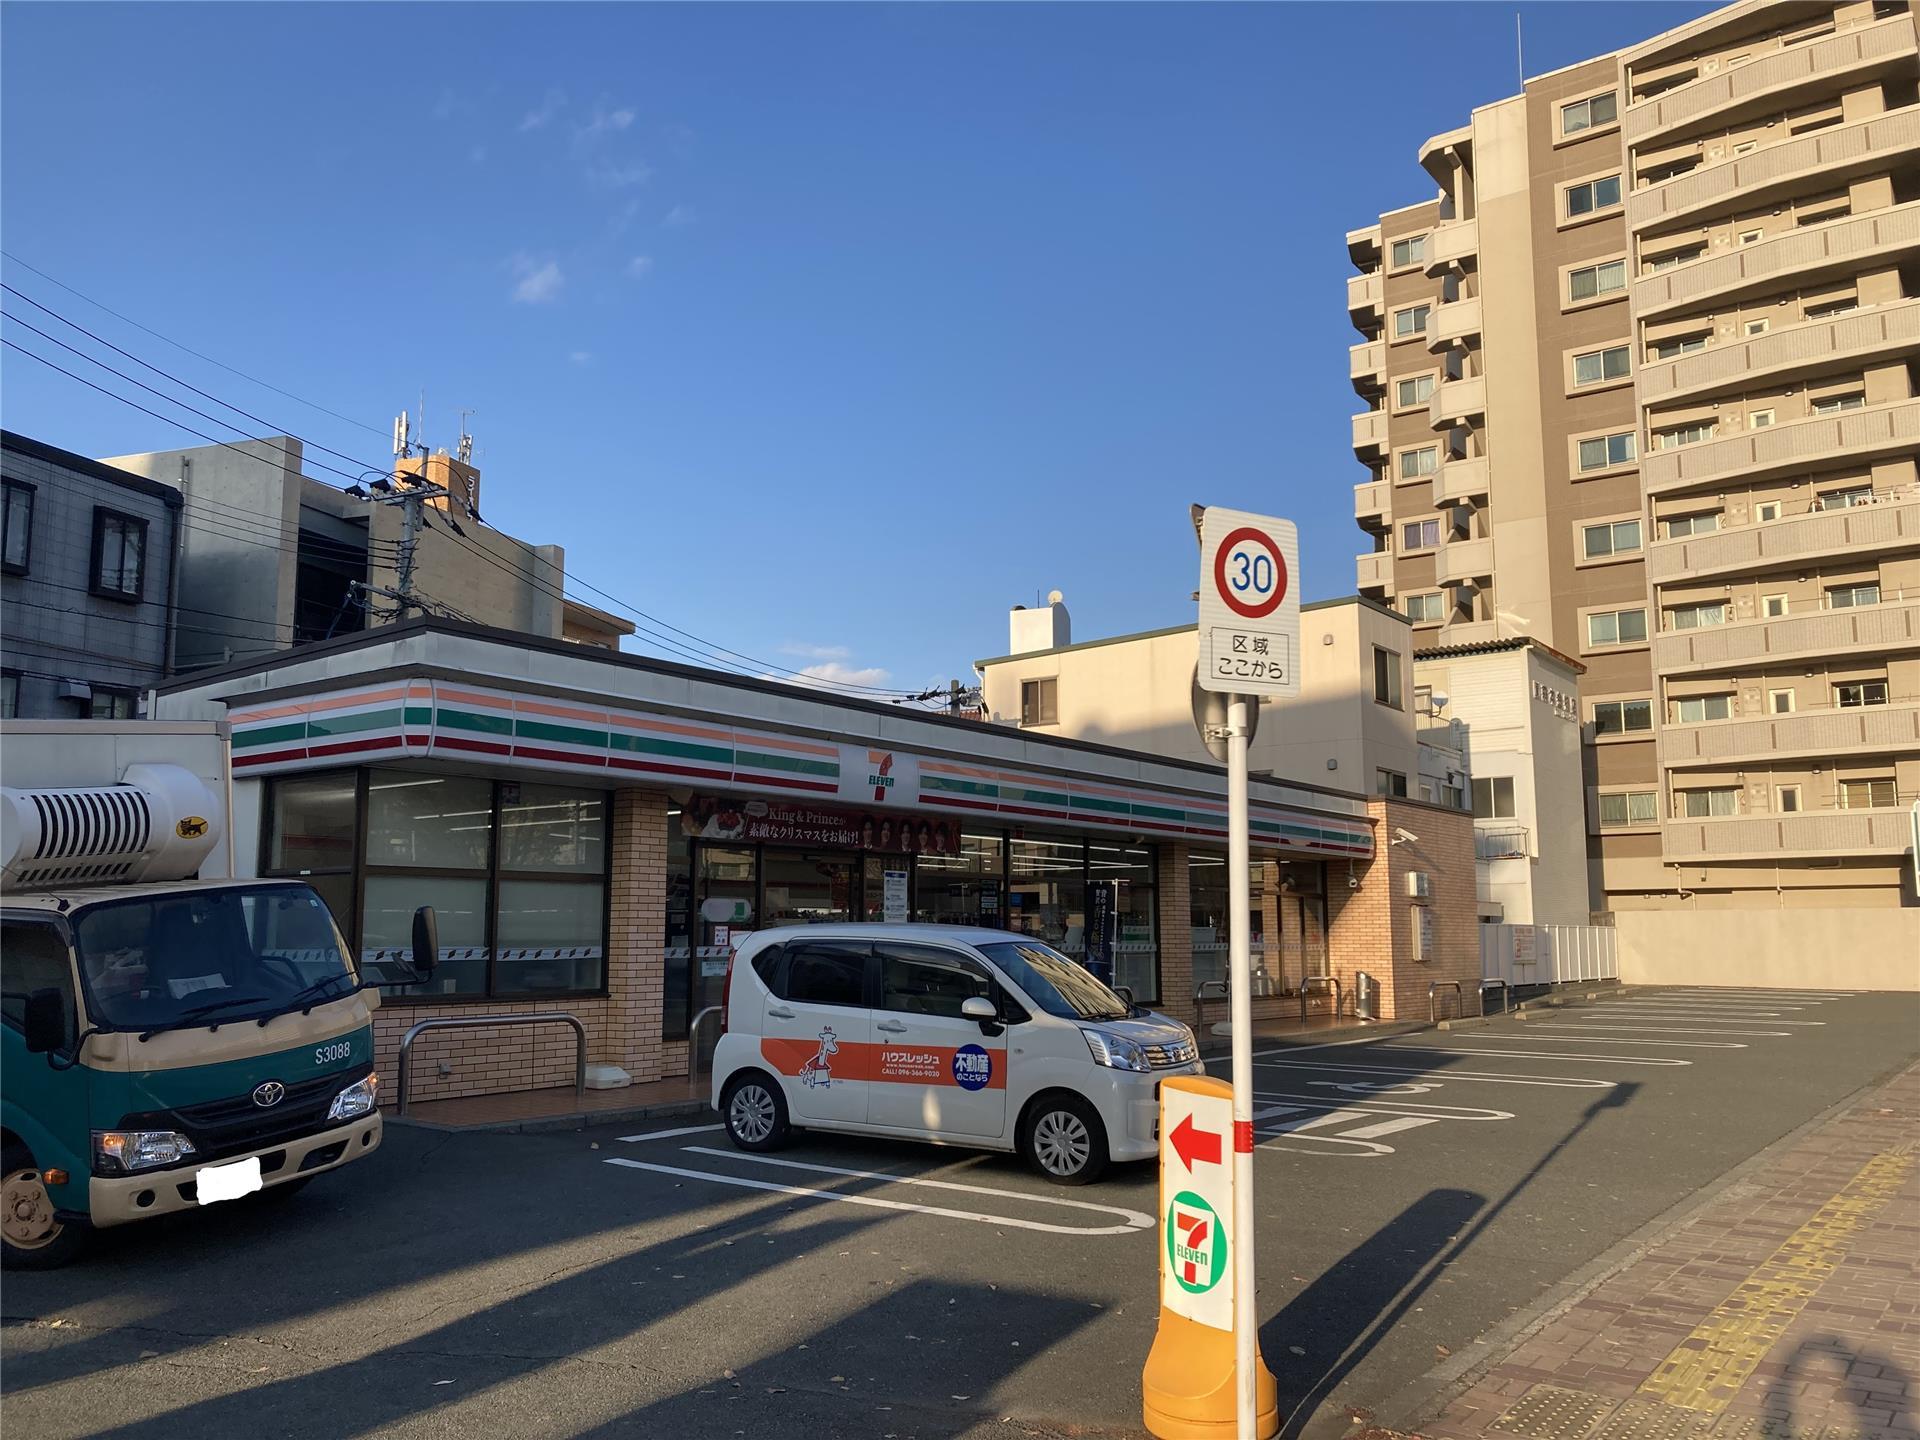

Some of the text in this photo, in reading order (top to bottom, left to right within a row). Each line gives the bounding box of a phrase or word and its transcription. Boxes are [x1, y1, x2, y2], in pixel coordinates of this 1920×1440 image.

[1232, 552, 1272, 594] 30
[1233, 635, 1269, 656] 区域
[1218, 657, 1283, 680] ここから
[868, 751, 893, 801] 7
[769, 807, 795, 824] King
[796, 811, 805, 822] &
[315, 1041, 351, 1065] S3088
[881, 1052, 940, 1065] ハウスレッシュ
[955, 1053, 989, 1073] 不動産
[956, 1073, 988, 1082] のことなら
[1177, 1211, 1208, 1285] 7
